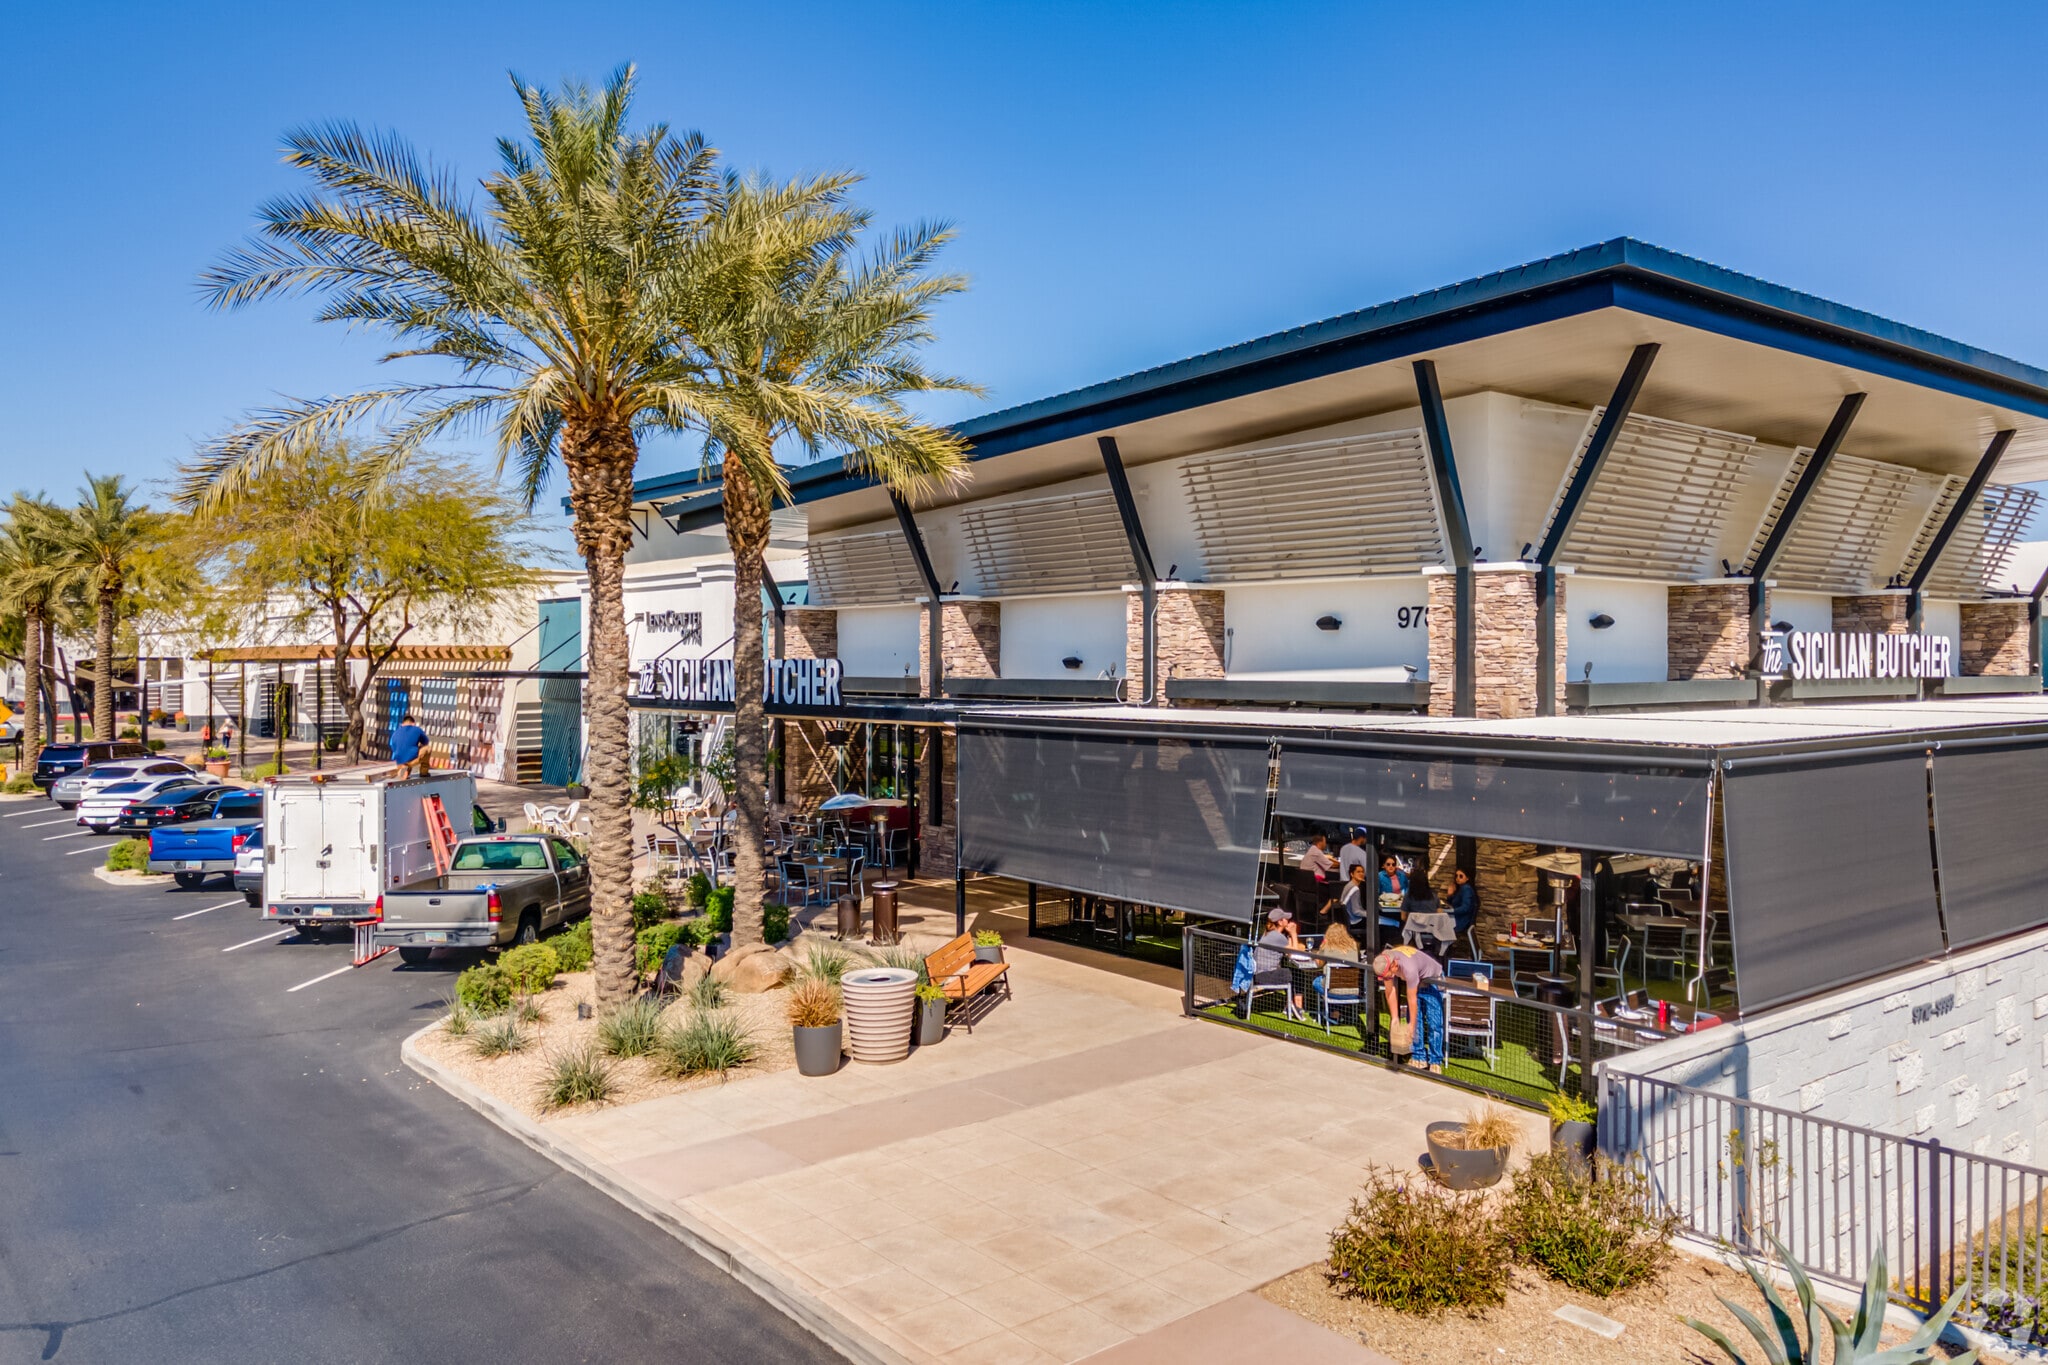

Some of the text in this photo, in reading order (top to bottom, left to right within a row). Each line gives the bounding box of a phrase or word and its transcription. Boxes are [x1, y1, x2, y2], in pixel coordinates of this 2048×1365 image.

[1397, 606, 1429, 628] 97
[1792, 631, 1870, 679] SICILIAN
[1876, 634, 1950, 678] BUTCHER
[662, 659, 736, 702] SICILIAN
